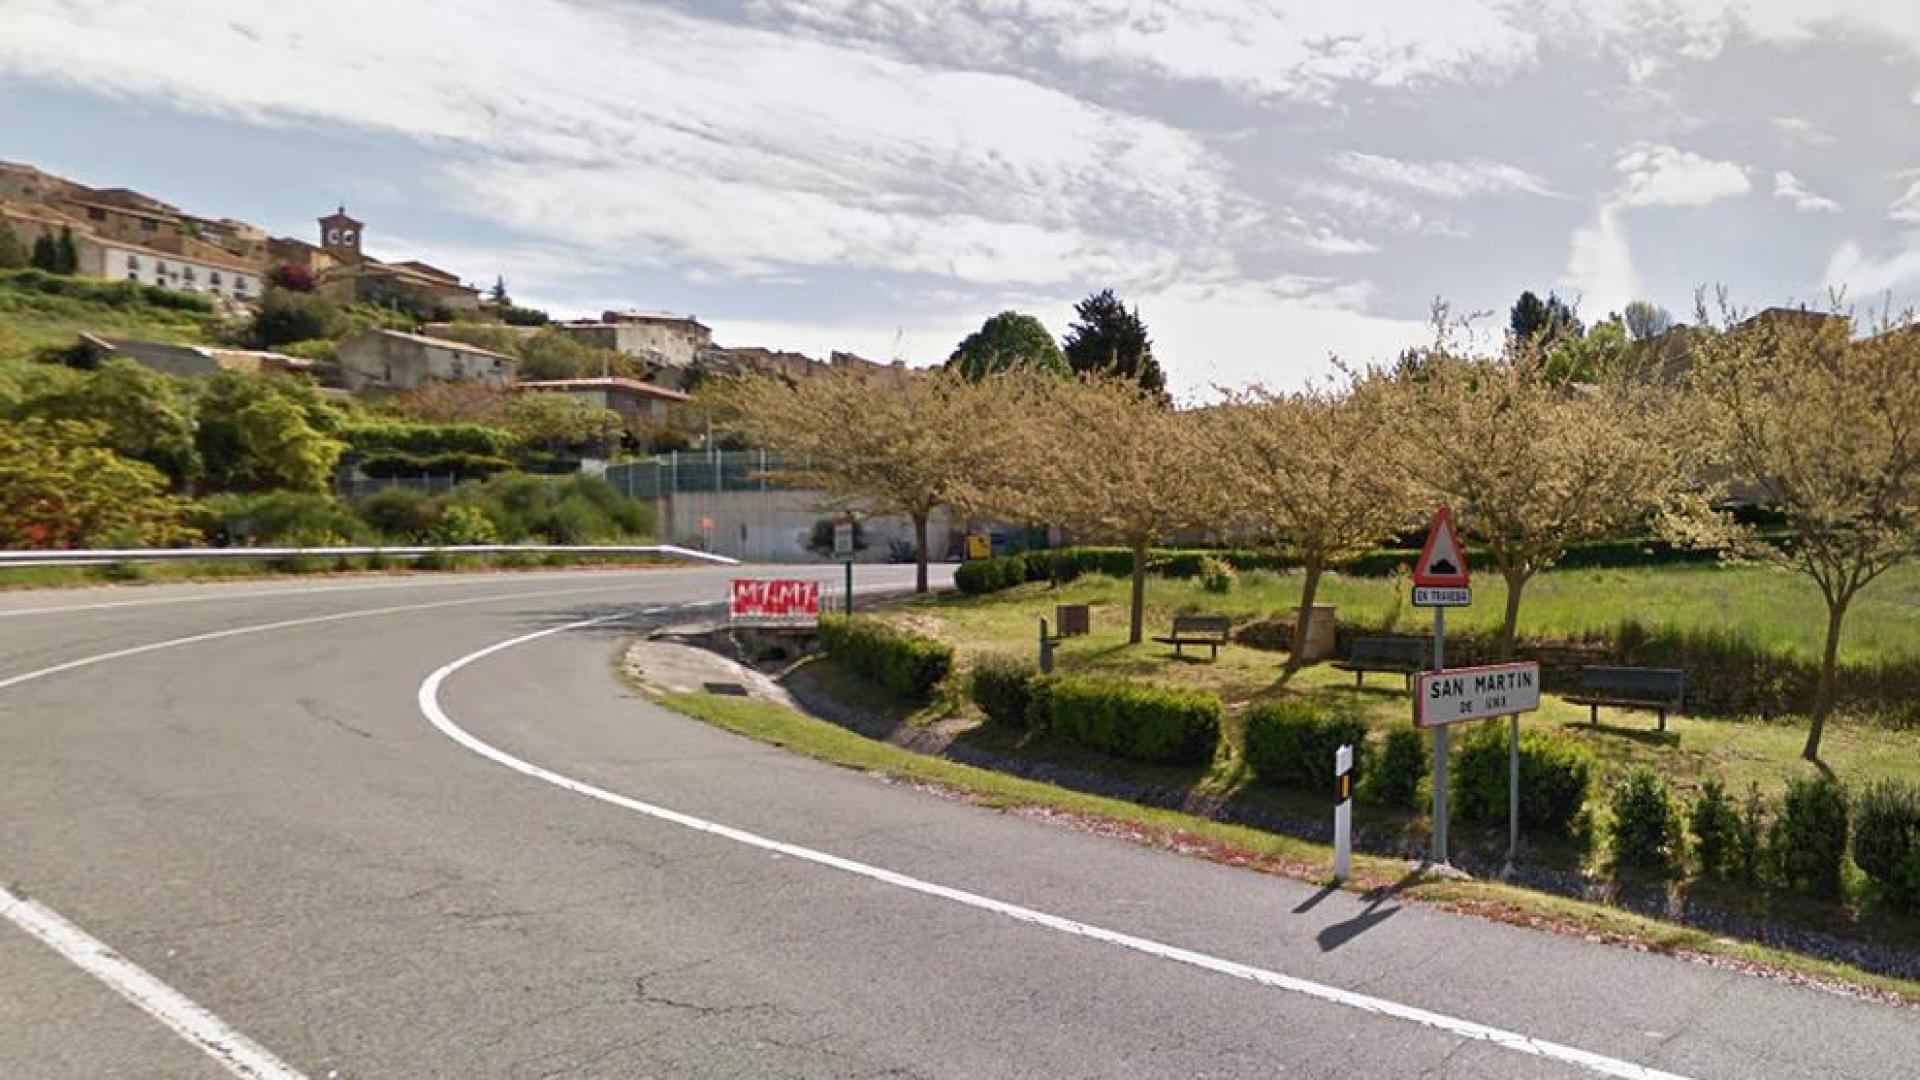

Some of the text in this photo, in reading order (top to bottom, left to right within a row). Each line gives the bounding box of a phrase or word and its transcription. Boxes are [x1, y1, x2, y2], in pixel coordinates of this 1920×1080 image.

[1430, 671, 1532, 699] SAN MARTIN
[1459, 700, 1472, 714] DE
